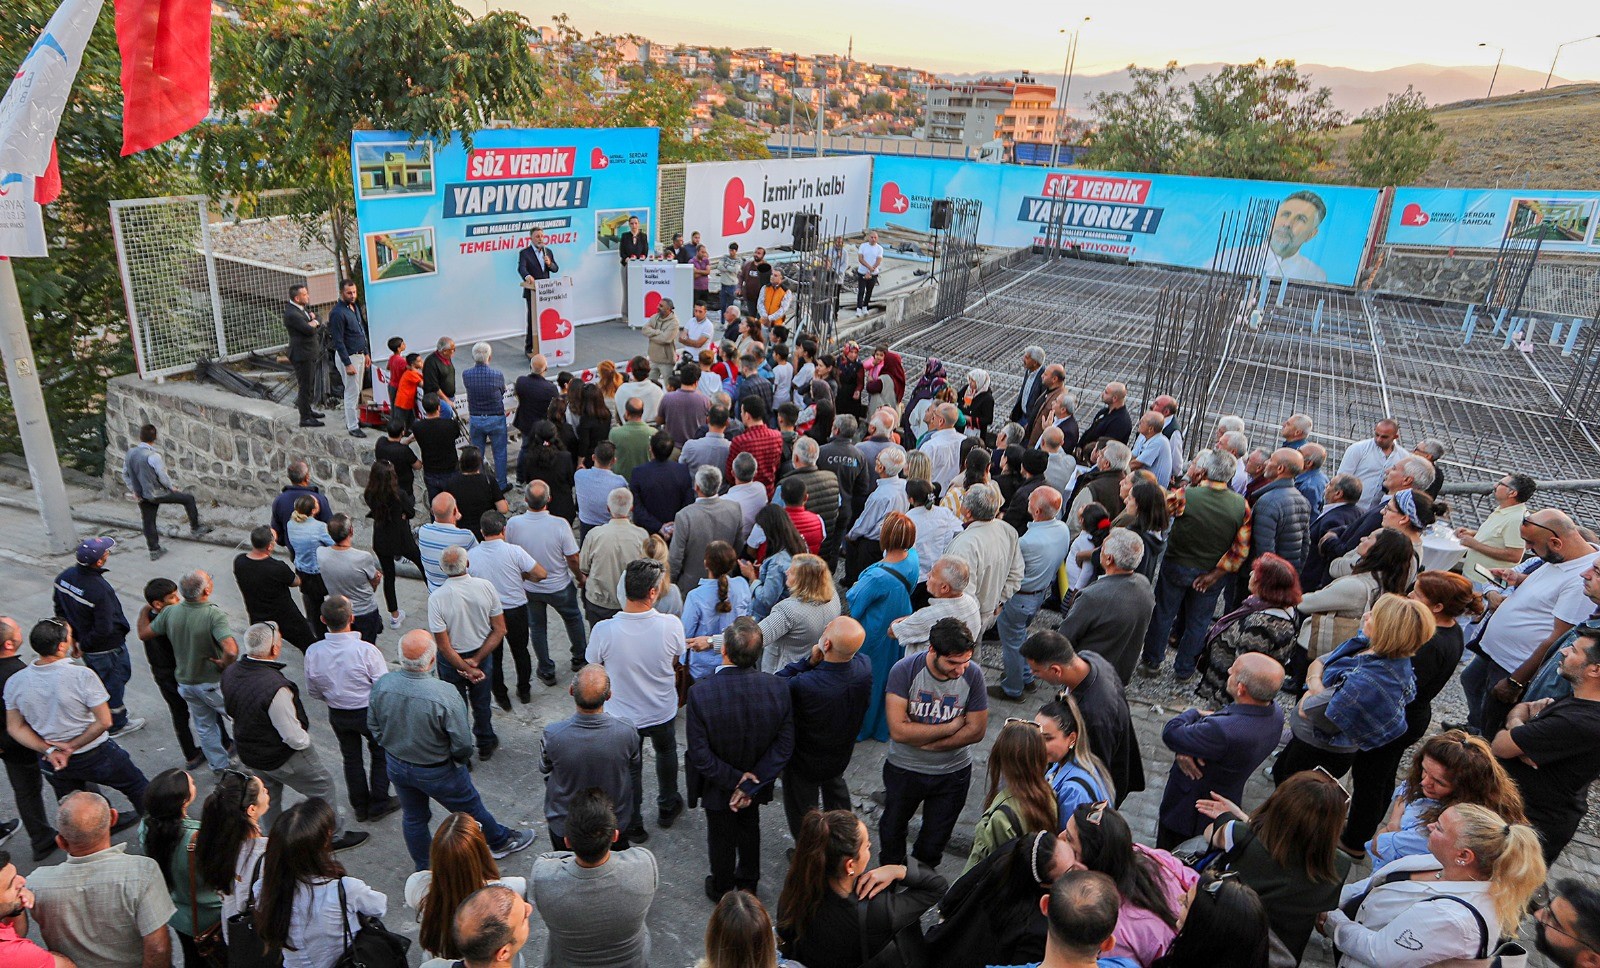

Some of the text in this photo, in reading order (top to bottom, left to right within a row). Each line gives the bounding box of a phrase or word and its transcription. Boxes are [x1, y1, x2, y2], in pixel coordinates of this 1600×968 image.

[471, 148, 569, 177] SÖZ VERDİK
[453, 181, 570, 215] YAPIYORUZ
[815, 174, 846, 197] kalbi
[1046, 175, 1143, 203] SÖZ VERDİK
[459, 235, 515, 255] TEMELİNİ
[516, 232, 571, 250] ATORUZ
